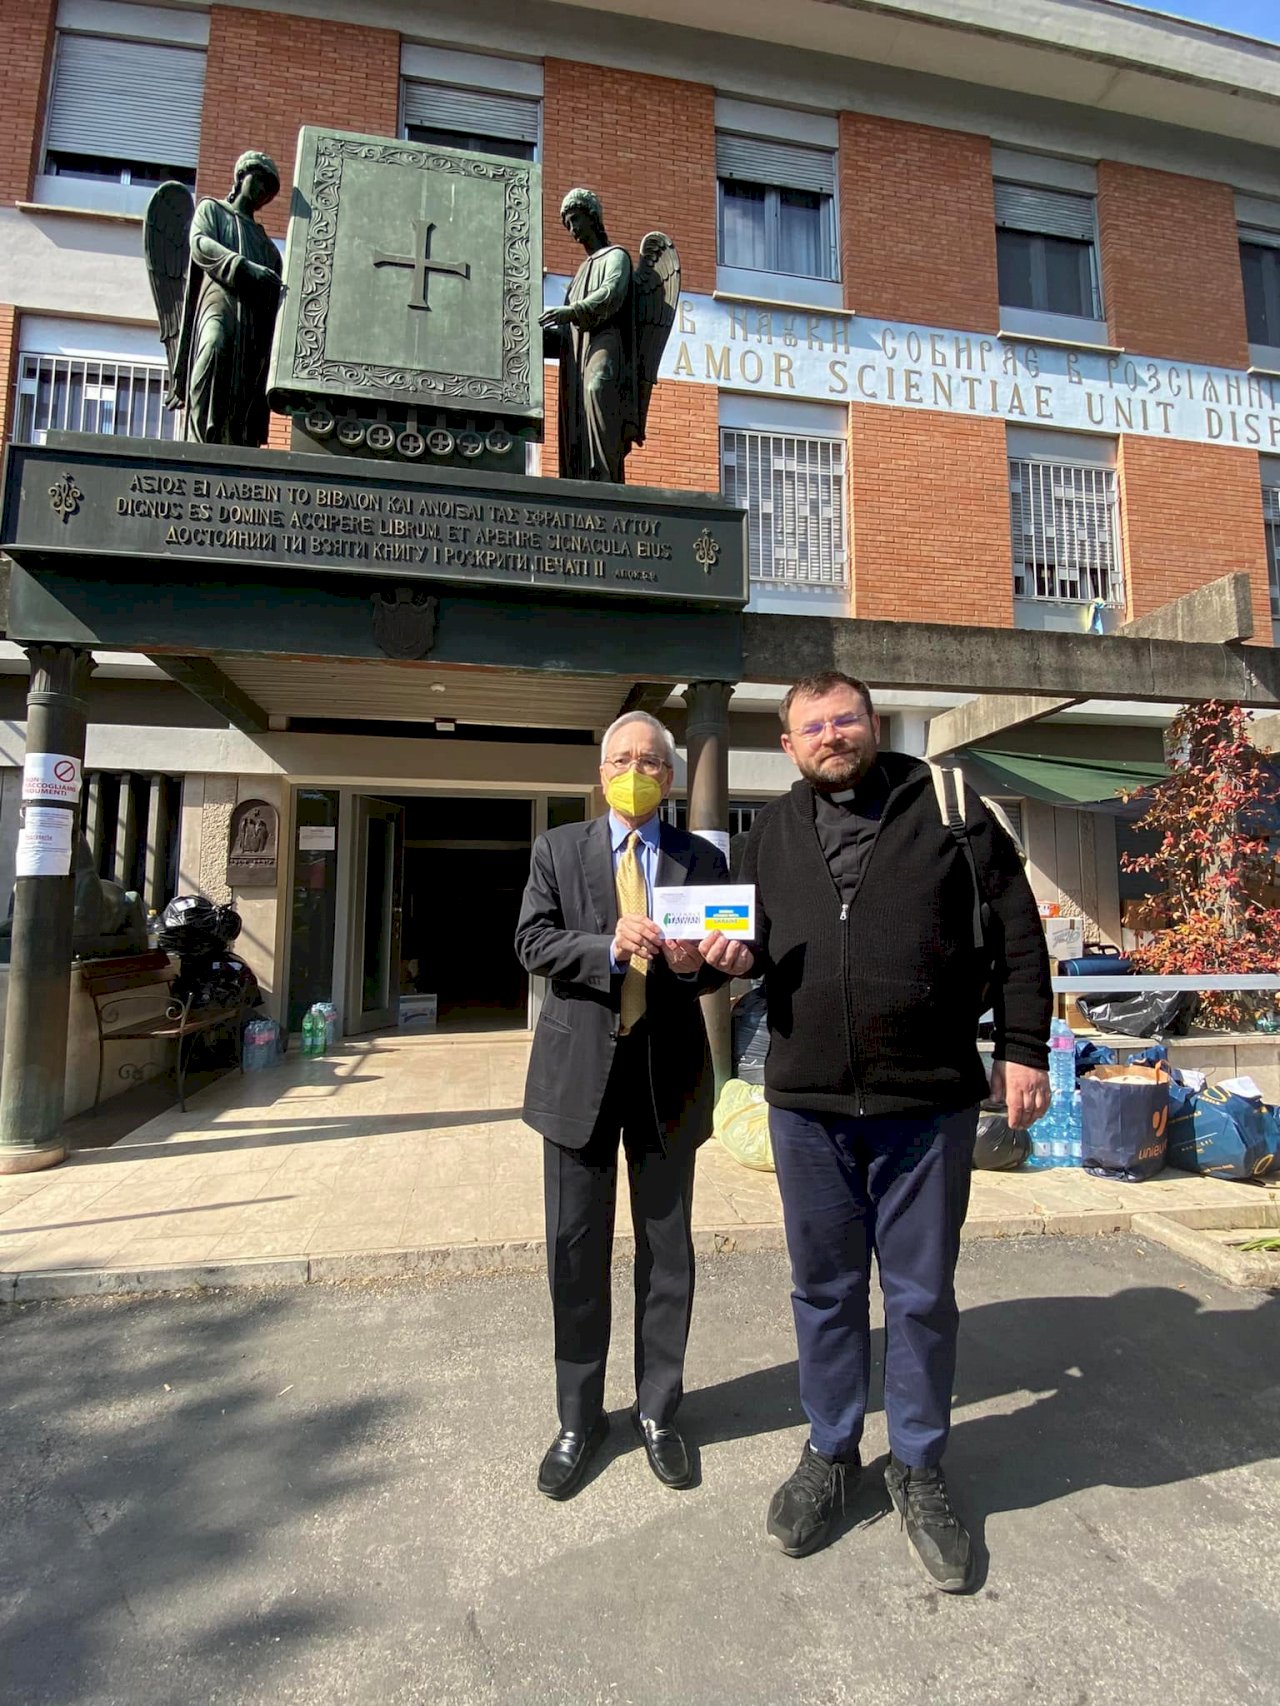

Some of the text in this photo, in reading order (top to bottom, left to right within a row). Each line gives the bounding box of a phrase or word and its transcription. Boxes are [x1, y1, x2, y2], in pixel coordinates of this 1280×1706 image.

[673, 341, 796, 389] AMOR
[828, 359, 1053, 418] SCIENTIAE
[1085, 391, 1175, 434] UNIT
[116, 496, 183, 518] DIGNUS
[189, 502, 211, 521] ES
[219, 505, 284, 527] DOMINE
[289, 510, 375, 535] ACCIPERE
[447, 524, 470, 543] ET
[475, 527, 542, 549] APERIRE
[547, 534, 632, 556] SIGNACULA
[637, 541, 672, 560] EIUS
[130, 474, 186, 495] ΑΞΙΟΣ
[193, 479, 209, 498] ΕΙ
[215, 481, 280, 502] ΛΑΒΕΙΝ
[288, 487, 309, 505] ΤΟ
[316, 488, 381, 512] ΒΙΒΛΙΟΝ
[387, 496, 413, 515] ΚΑΙ
[489, 505, 519, 524] ΤΑΣ
[612, 517, 661, 536] ΑΥΤΟΥ
[282, 534, 305, 552] ТИ
[310, 536, 368, 559] ВЗЯТИ
[373, 541, 428, 562] КНИГУ
[444, 547, 528, 571] РОЗКРИТИ
[534, 555, 589, 577] ПЕЧАТІ
